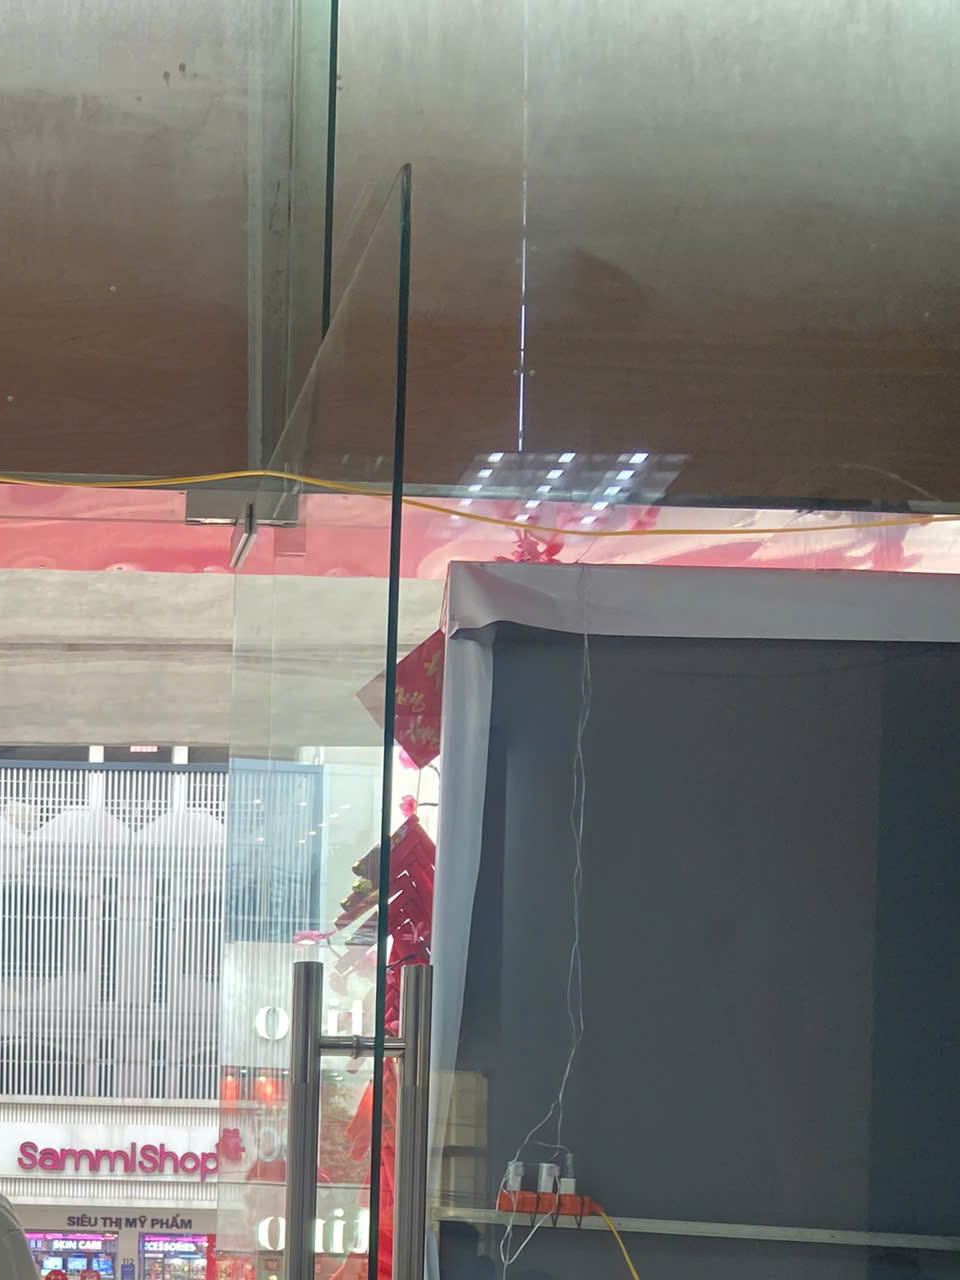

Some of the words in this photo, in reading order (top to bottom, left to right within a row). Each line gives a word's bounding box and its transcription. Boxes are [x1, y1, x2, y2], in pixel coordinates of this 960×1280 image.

[17, 1141, 219, 1182] SammiShop
[67, 1216, 98, 1227] SIÊU
[101, 1217, 122, 1229] THỊ
[125, 1216, 149, 1228] MỸ
[151, 1214, 192, 1229] PHẨM
[53, 1240, 76, 1250] SKIN
[78, 1240, 102, 1250] CARE
